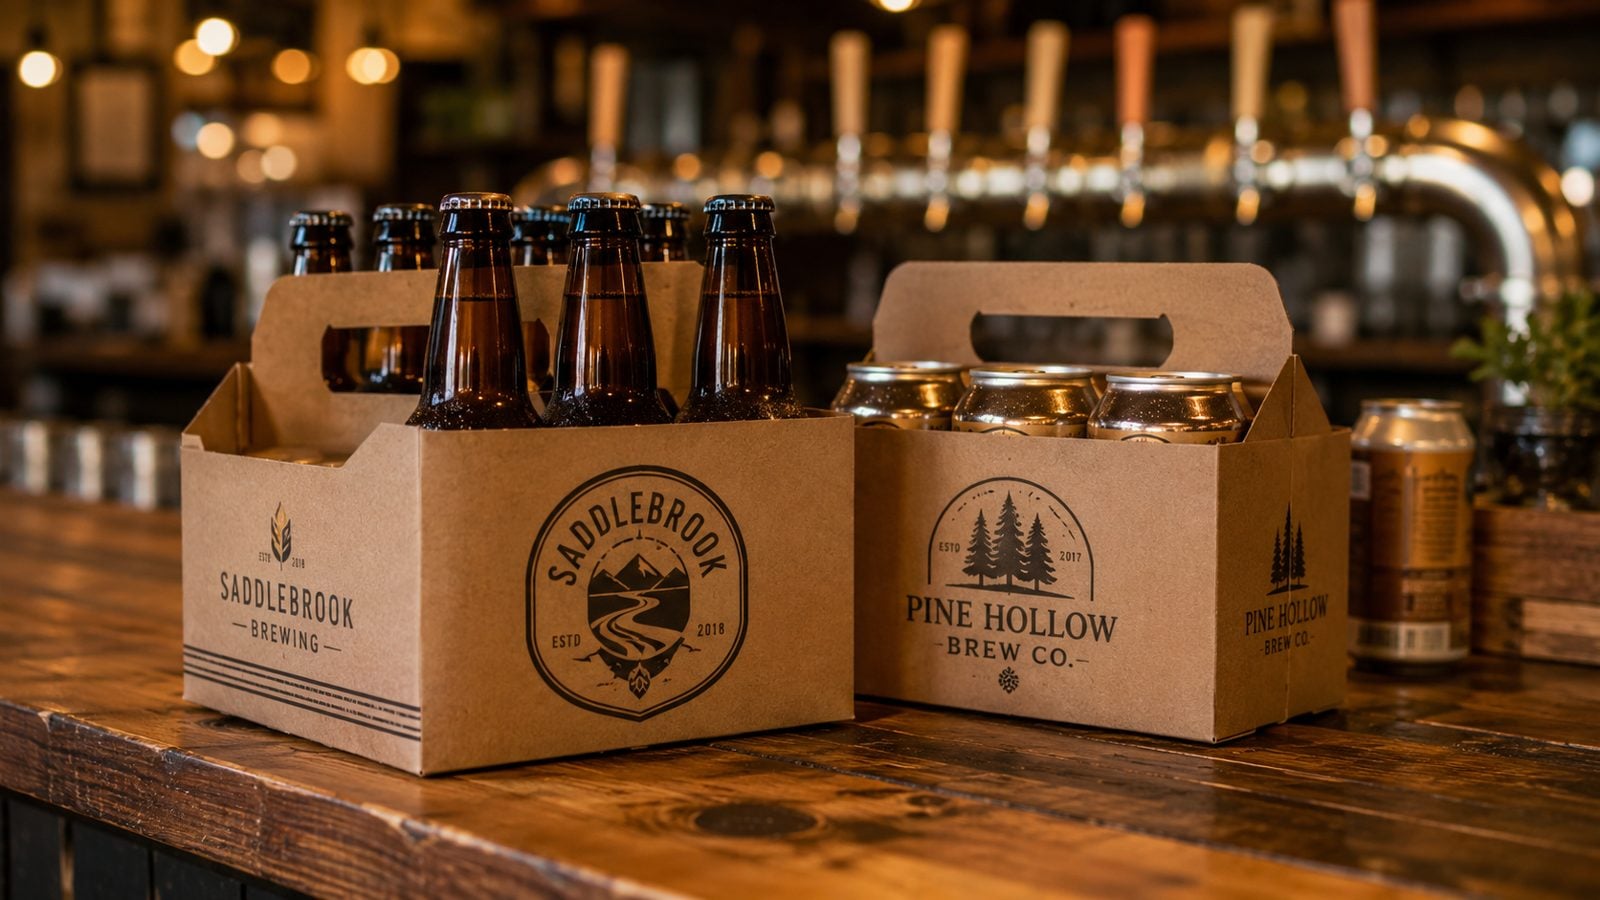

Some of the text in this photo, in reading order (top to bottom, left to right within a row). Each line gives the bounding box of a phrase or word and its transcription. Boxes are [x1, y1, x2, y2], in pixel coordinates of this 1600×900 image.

[548, 491, 728, 587] SADDLEBROOK
[938, 541, 961, 553] ESTD
[1059, 551, 1082, 562] 2017
[220, 571, 354, 629] SADDLEBROOK
[1245, 593, 1328, 636] PINE HOLLOW
[251, 617, 319, 653] BREWING
[697, 623, 725, 638] 2018
[906, 594, 1119, 643] PINE HOLLOW
[552, 633, 582, 649] ESTD
[947, 635, 1073, 668] BREW CO.
[1264, 635, 1292, 656] BREW
